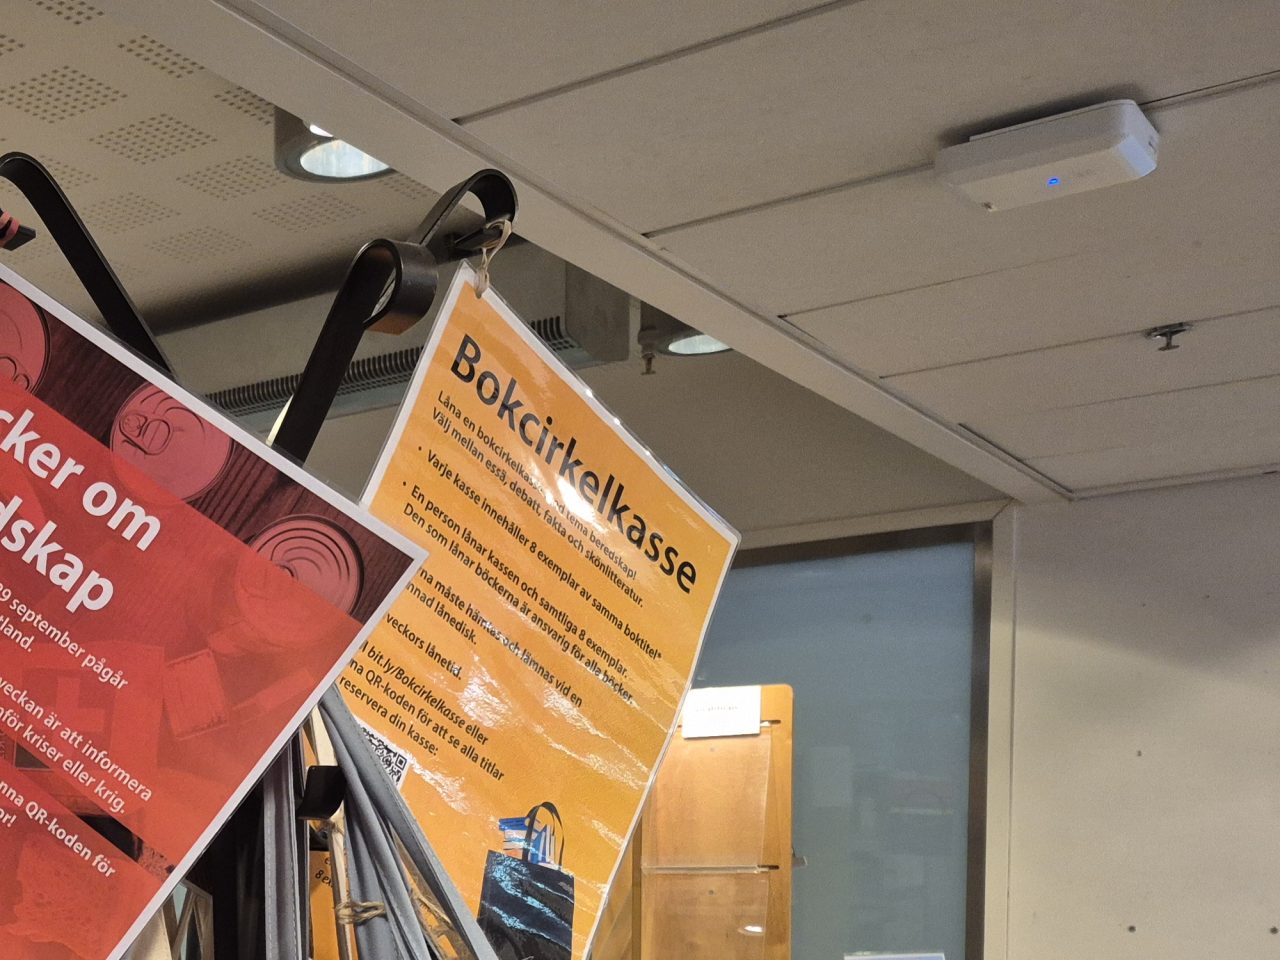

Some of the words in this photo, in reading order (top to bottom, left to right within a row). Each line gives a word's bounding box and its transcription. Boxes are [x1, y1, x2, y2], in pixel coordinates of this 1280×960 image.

[432, 406, 452, 434] Välj
[450, 427, 484, 463] mellan
[485, 459, 507, 486] essä,
[509, 480, 541, 517] debatt,
[543, 509, 567, 538] fakta
[567, 534, 584, 553] och
[584, 549, 643, 608] skönlitteratur.
[437, 390, 462, 419] Låna
[462, 416, 476, 432] en
[565, 510, 588, 537] tema
[588, 530, 637, 581] beredskap!
[450, 333, 696, 594] Bokcirkelkasse
[82, 481, 161, 551] om
[427, 449, 453, 480] Varje
[452, 472, 481, 505] kasse
[480, 497, 530, 546] innehåller
[529, 541, 537, 554] 8
[536, 550, 580, 591] exemplar
[579, 587, 592, 601] av
[591, 598, 623, 630] samma
[403, 502, 425, 528] Den
[425, 523, 448, 547] som
[448, 539, 475, 568] lånar
[474, 561, 519, 608] böckerna
[519, 600, 532, 616] är
[530, 612, 570, 653] ansvarig
[570, 643, 585, 661] för
[584, 658, 602, 676] alla
[601, 669, 633, 704] böcker.
[411, 484, 425, 504] En
[424, 499, 461, 535] person
[461, 527, 488, 556] lånar
[486, 549, 520, 586] kassen
[520, 581, 538, 602] och
[538, 597, 578, 635] samtliga
[578, 628, 586, 641] 8
[585, 637, 627, 678] exemplar.
[433, 600, 477, 645] lånedisk.
[9, 598, 85, 657] september
[81, 654, 128, 689] pågår
[386, 613, 425, 649] veckors
[424, 641, 462, 680] lånetid.
[433, 580, 465, 611] måste
[520, 647, 555, 684] lämnas
[555, 678, 571, 697] vid
[569, 692, 582, 708] en
[339, 676, 388, 718] reservera
[388, 713, 406, 732] din
[406, 724, 438, 756] kasse:
[365, 669, 416, 715] QR-koden
[416, 708, 433, 727] för
[431, 722, 448, 740] att
[447, 734, 460, 749] se
[460, 744, 479, 763] alla
[479, 756, 505, 781] titlar
[367, 645, 466, 729] bit.ly/Bokcirkelkasse
[465, 724, 488, 745] eller
[22, 724, 64, 762] kriser
[62, 759, 96, 786] eller
[93, 779, 125, 814] krig.
[43, 711, 62, 730] är
[59, 727, 83, 748] att
[81, 740, 152, 801] informera
[25, 800, 92, 860] QR-koden
[91, 854, 116, 877] för
